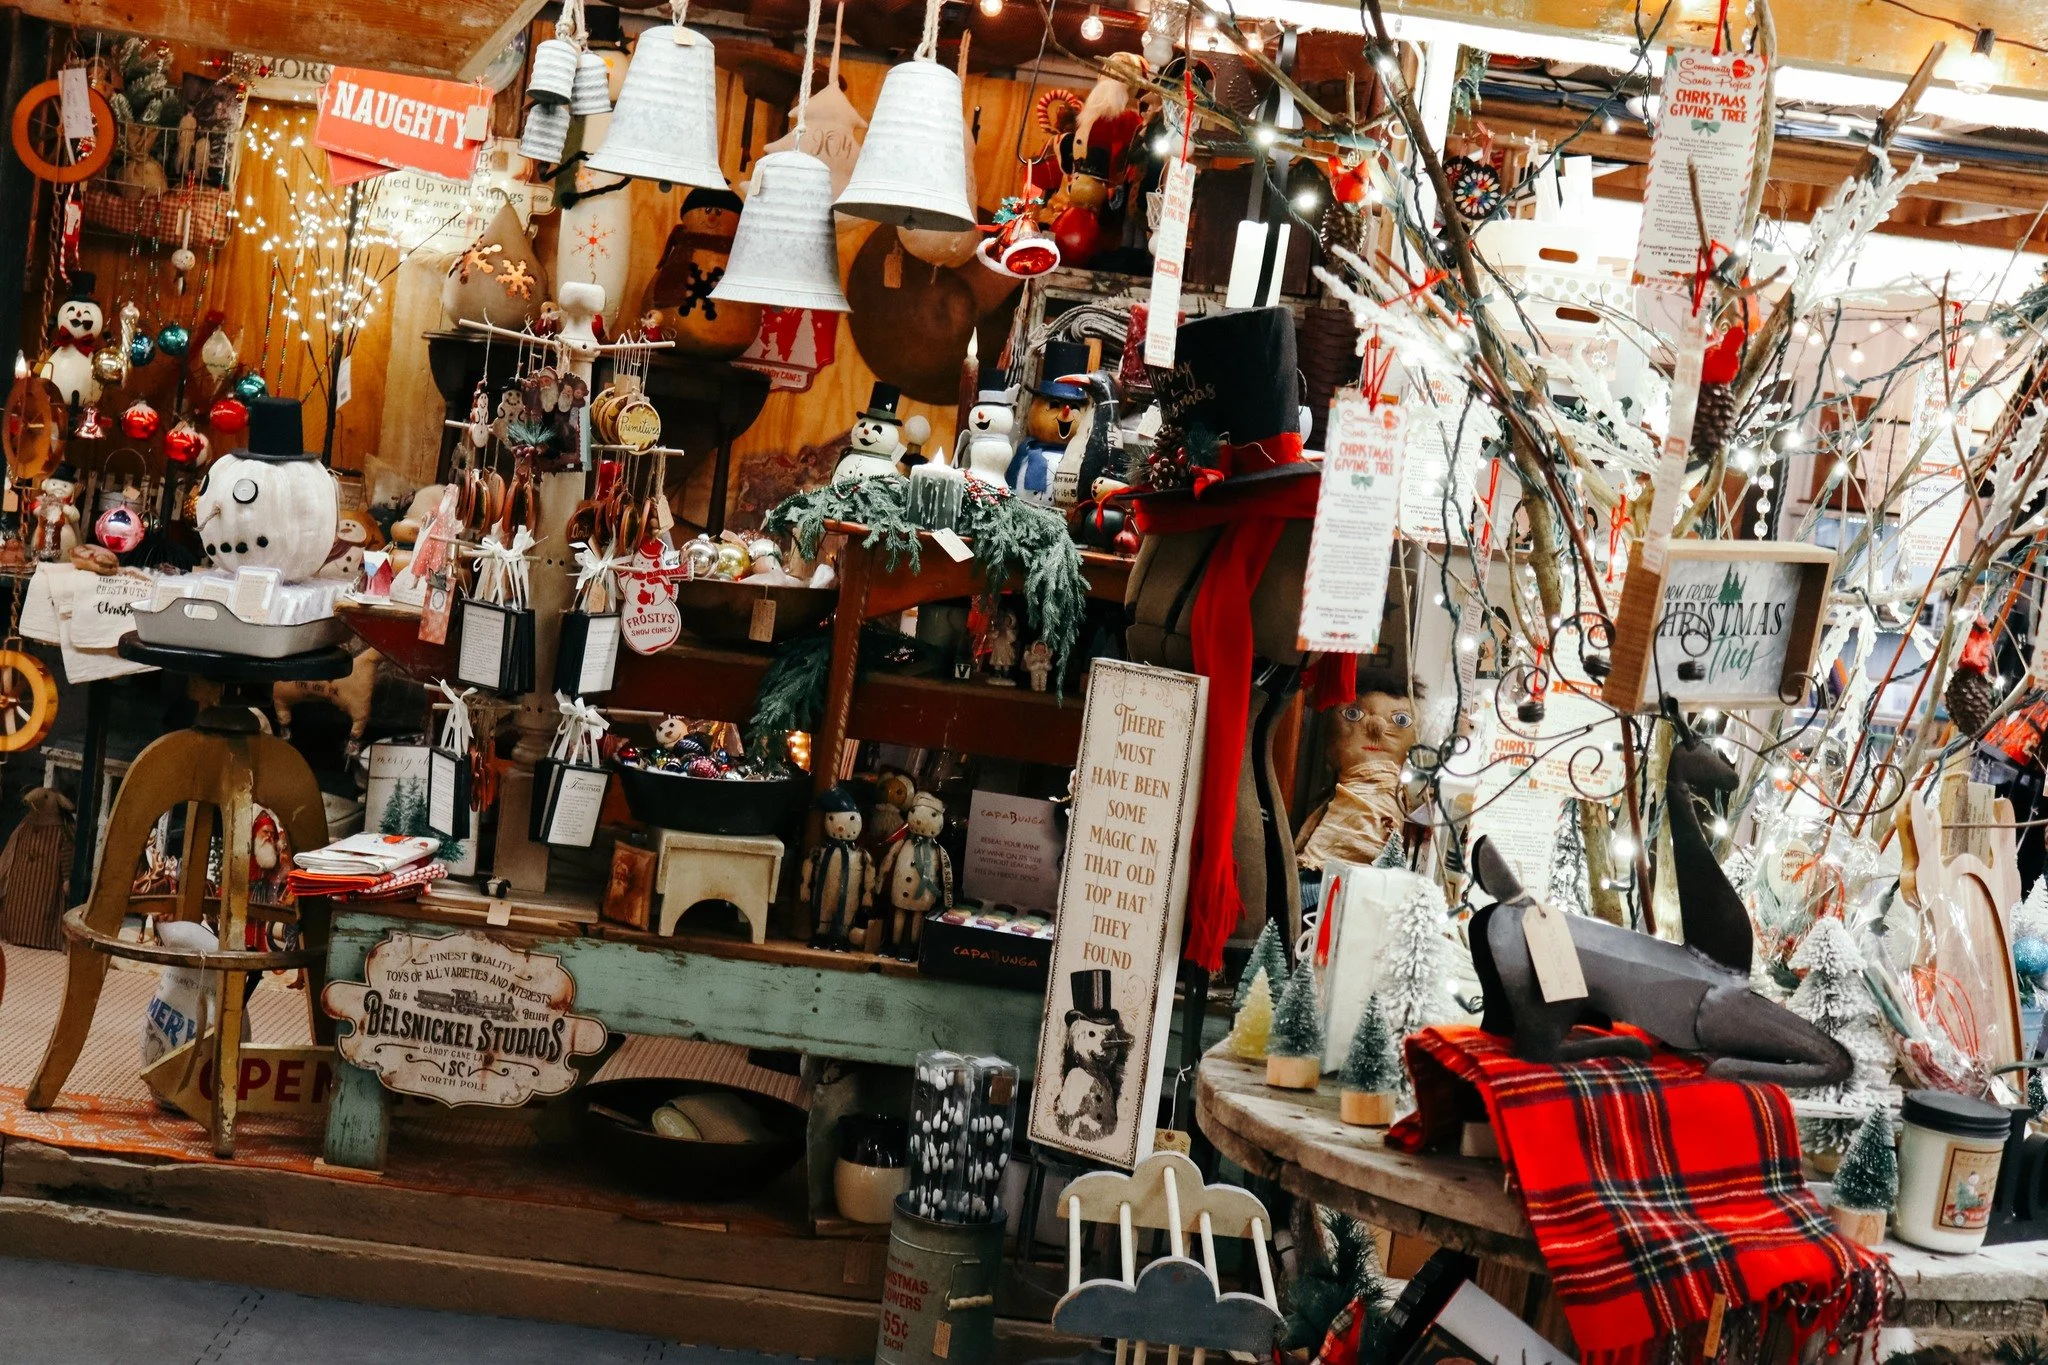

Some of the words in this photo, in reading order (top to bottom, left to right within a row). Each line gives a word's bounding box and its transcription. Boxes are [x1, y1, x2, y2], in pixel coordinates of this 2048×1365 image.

[1680, 58, 1731, 77] Community
[1679, 71, 1712, 86] Santa
[1715, 75, 1752, 92] Project
[1676, 88, 1747, 110] CHRISTMAS
[331, 80, 468, 150] NAUGHTY
[1670, 103, 1714, 120] GIVING
[1721, 108, 1747, 123] TREE
[416, 178, 435, 193] Up
[1339, 443, 1394, 461] CHRISTMAS
[1334, 459, 1368, 474] GIVING
[1375, 461, 1394, 476] TREE
[96, 585, 148, 598] CHESTNUTS
[626, 613, 675, 629] FROSTYS
[1659, 602, 1786, 637] HRISTMAS
[631, 628, 650, 637] SNOW
[651, 627, 673, 635] CONES
[1114, 703, 1166, 738] THERE
[1115, 741, 1156, 766] MUST
[1091, 766, 1129, 790] HAVE
[1134, 775, 1170, 799] BEEN
[1107, 800, 1148, 824] SOME
[1004, 839, 1022, 849] YOUR
[1022, 842, 1040, 851] WINE
[1089, 825, 1137, 852] MAGIC
[1139, 837, 1157, 857] IN
[979, 856, 1009, 867] WITHOUT
[1010, 861, 1039, 871] LEAKING
[987, 850, 1005, 859] WINE
[1006, 853, 1019, 861] ON
[1019, 873, 1040, 883] DOOR
[1084, 853, 1123, 878] THAT
[1126, 864, 1155, 886] OLD
[1085, 883, 1112, 905] TOP
[1116, 891, 1147, 914] HAT
[1092, 914, 1132, 940] THEY
[430, 952, 468, 963] FINEST
[471, 952, 516, 974] QUALITY
[1083, 942, 1132, 971] FOUND
[386, 970, 410, 982] TOYS
[411, 971, 423, 983] OF
[425, 969, 442, 980] ALL
[445, 967, 489, 981] VARIETIES
[489, 973, 509, 988] AND
[508, 980, 552, 1005] INTERESTS
[389, 988, 402, 1000] SEE
[522, 1008, 550, 1022] BELIEVE
[363, 989, 474, 1049] BELSNICKEL
[475, 1017, 566, 1064] STUDIOS
[423, 1046, 449, 1057] CANDY
[451, 1050, 471, 1060] CANE
[447, 1060, 465, 1077] SC
[420, 1073, 456, 1087] NORTH
[884, 1336, 904, 1352] EACH
